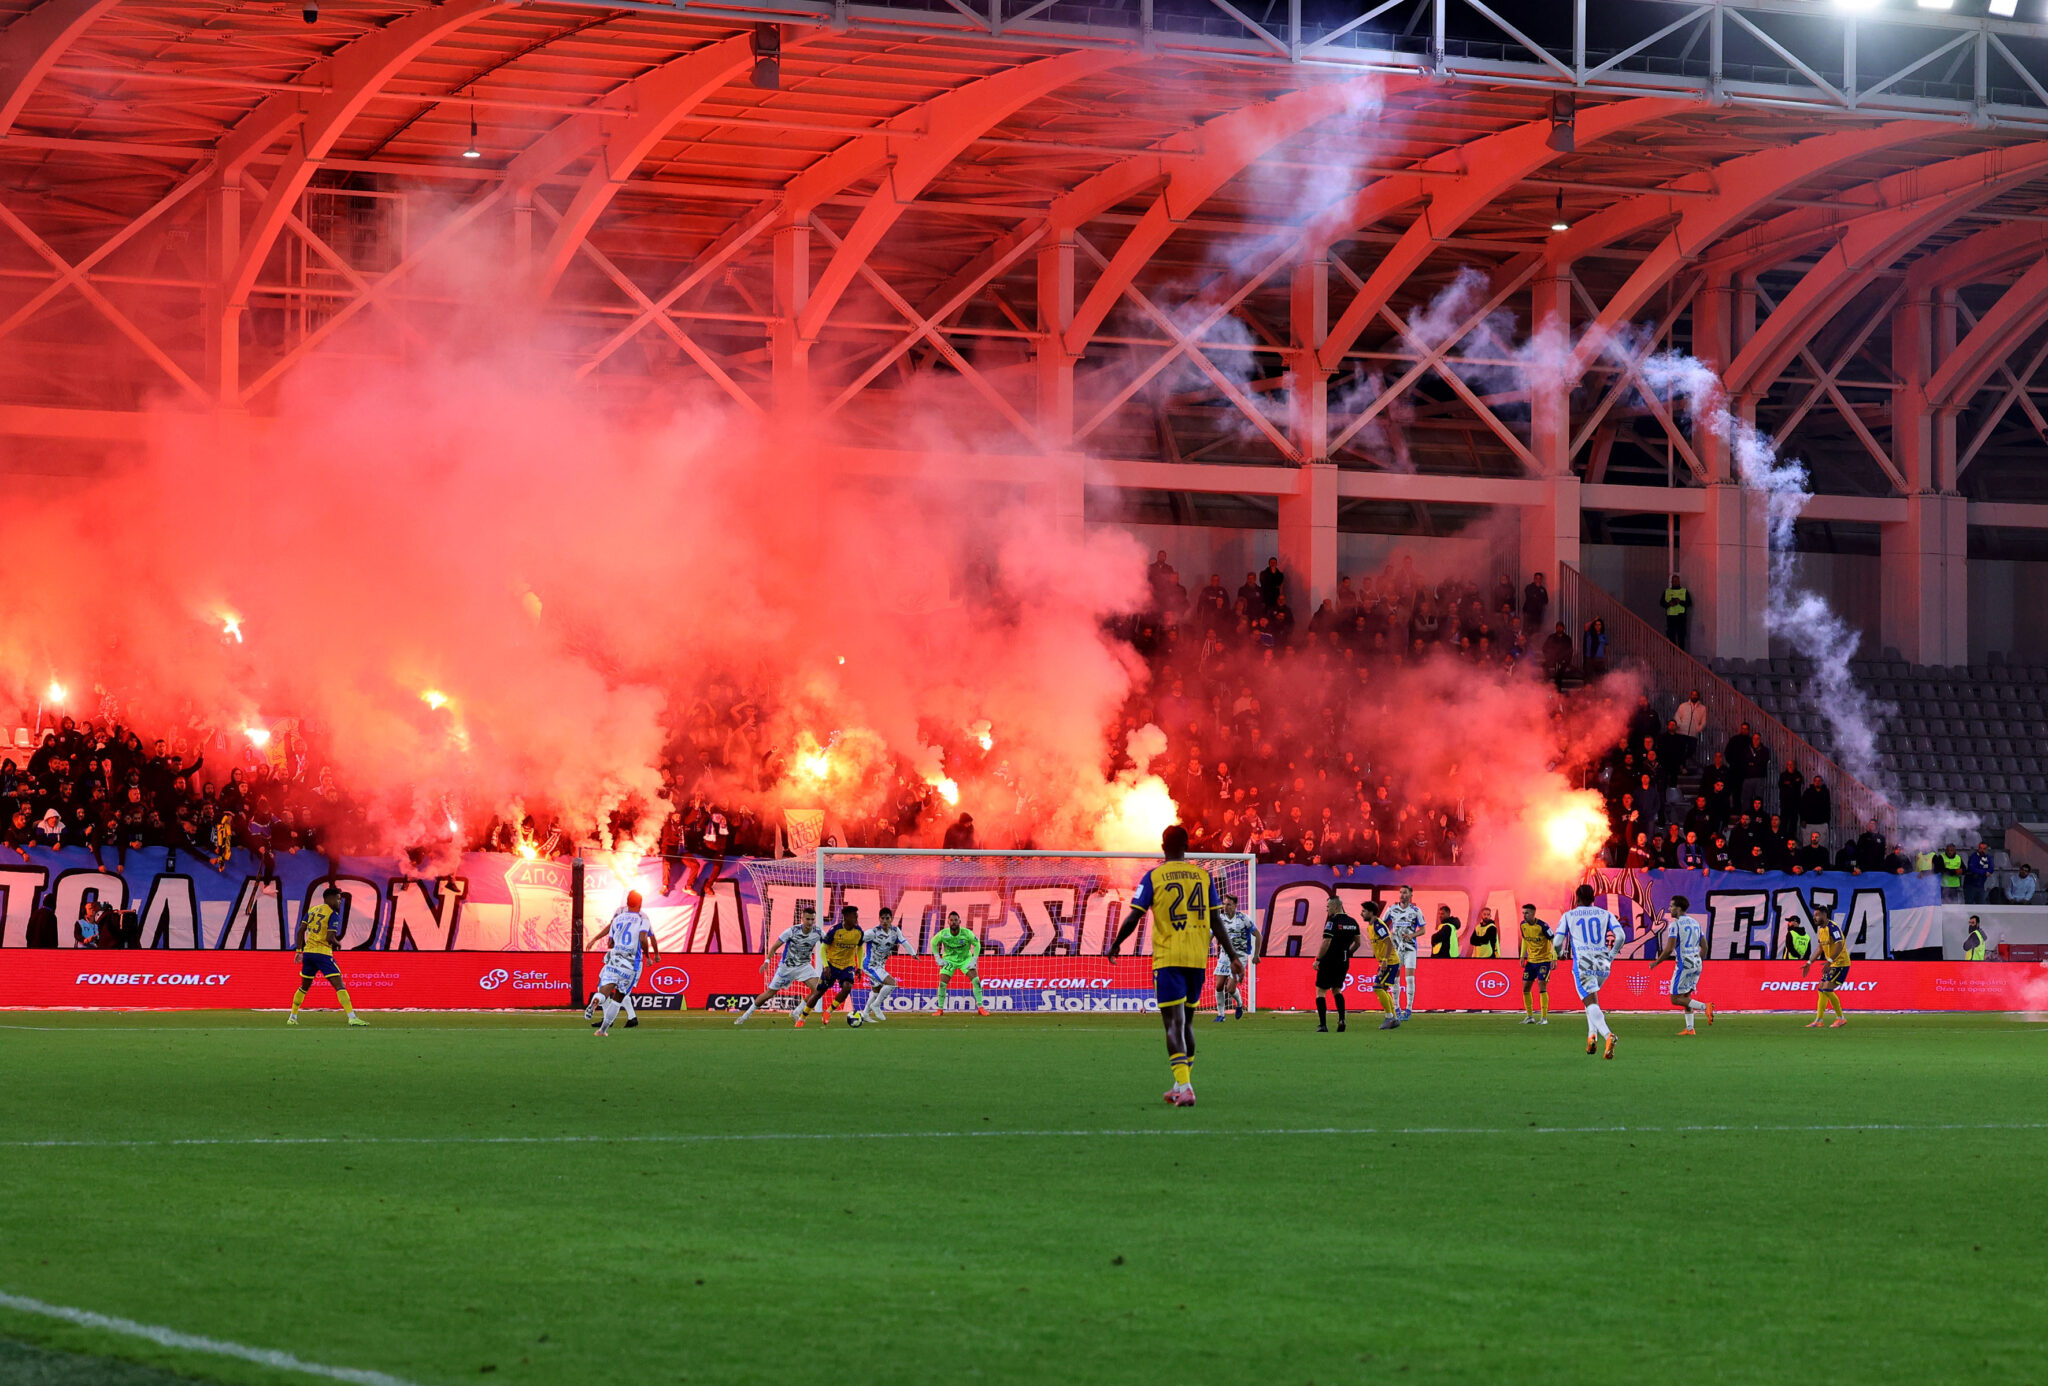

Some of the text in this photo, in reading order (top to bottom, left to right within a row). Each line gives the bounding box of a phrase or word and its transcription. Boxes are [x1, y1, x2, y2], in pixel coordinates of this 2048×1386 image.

[521, 868, 607, 889] ΑΠΟΛΩΝ
[1164, 882, 1206, 921] 24
[307, 912, 325, 933] 23
[1576, 917, 1601, 945] 10
[75, 974, 231, 986] FONBET.COM.CY
[513, 970, 549, 980] Safer
[655, 975, 685, 986] 18+
[1358, 974, 1377, 983] Saf
[980, 978, 1113, 989] FONBET.COM.CY
[1480, 979, 1505, 989] 18+
[1760, 980, 1878, 991] FONBETM.CY
[631, 995, 675, 1008] YBET
[883, 992, 1013, 1011] toiximan
[1038, 990, 1159, 1011] Stoixima
